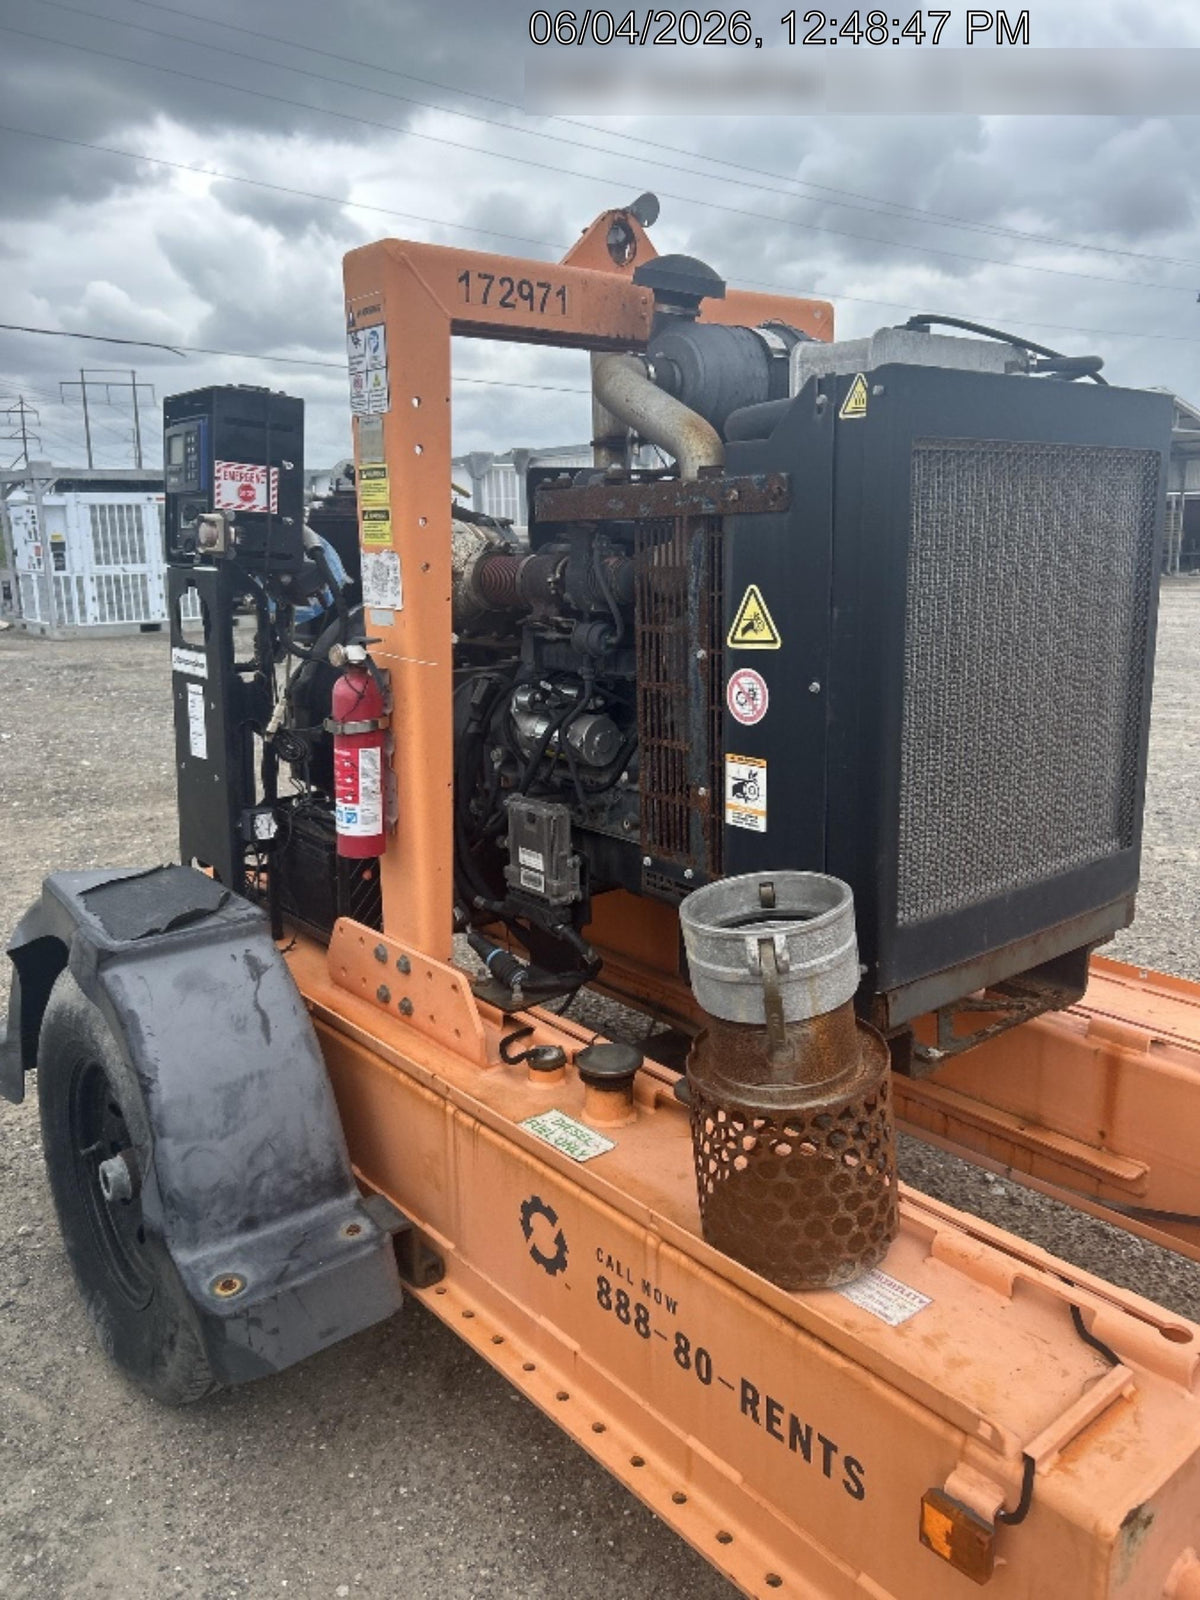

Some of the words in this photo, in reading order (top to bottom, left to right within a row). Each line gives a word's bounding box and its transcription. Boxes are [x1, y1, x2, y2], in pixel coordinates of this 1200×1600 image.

[457, 269, 568, 315] 172971
[596, 1247, 634, 1287] CALL
[641, 1278, 678, 1315] NOW
[596, 1275, 866, 1501] 888-80-RENTS
